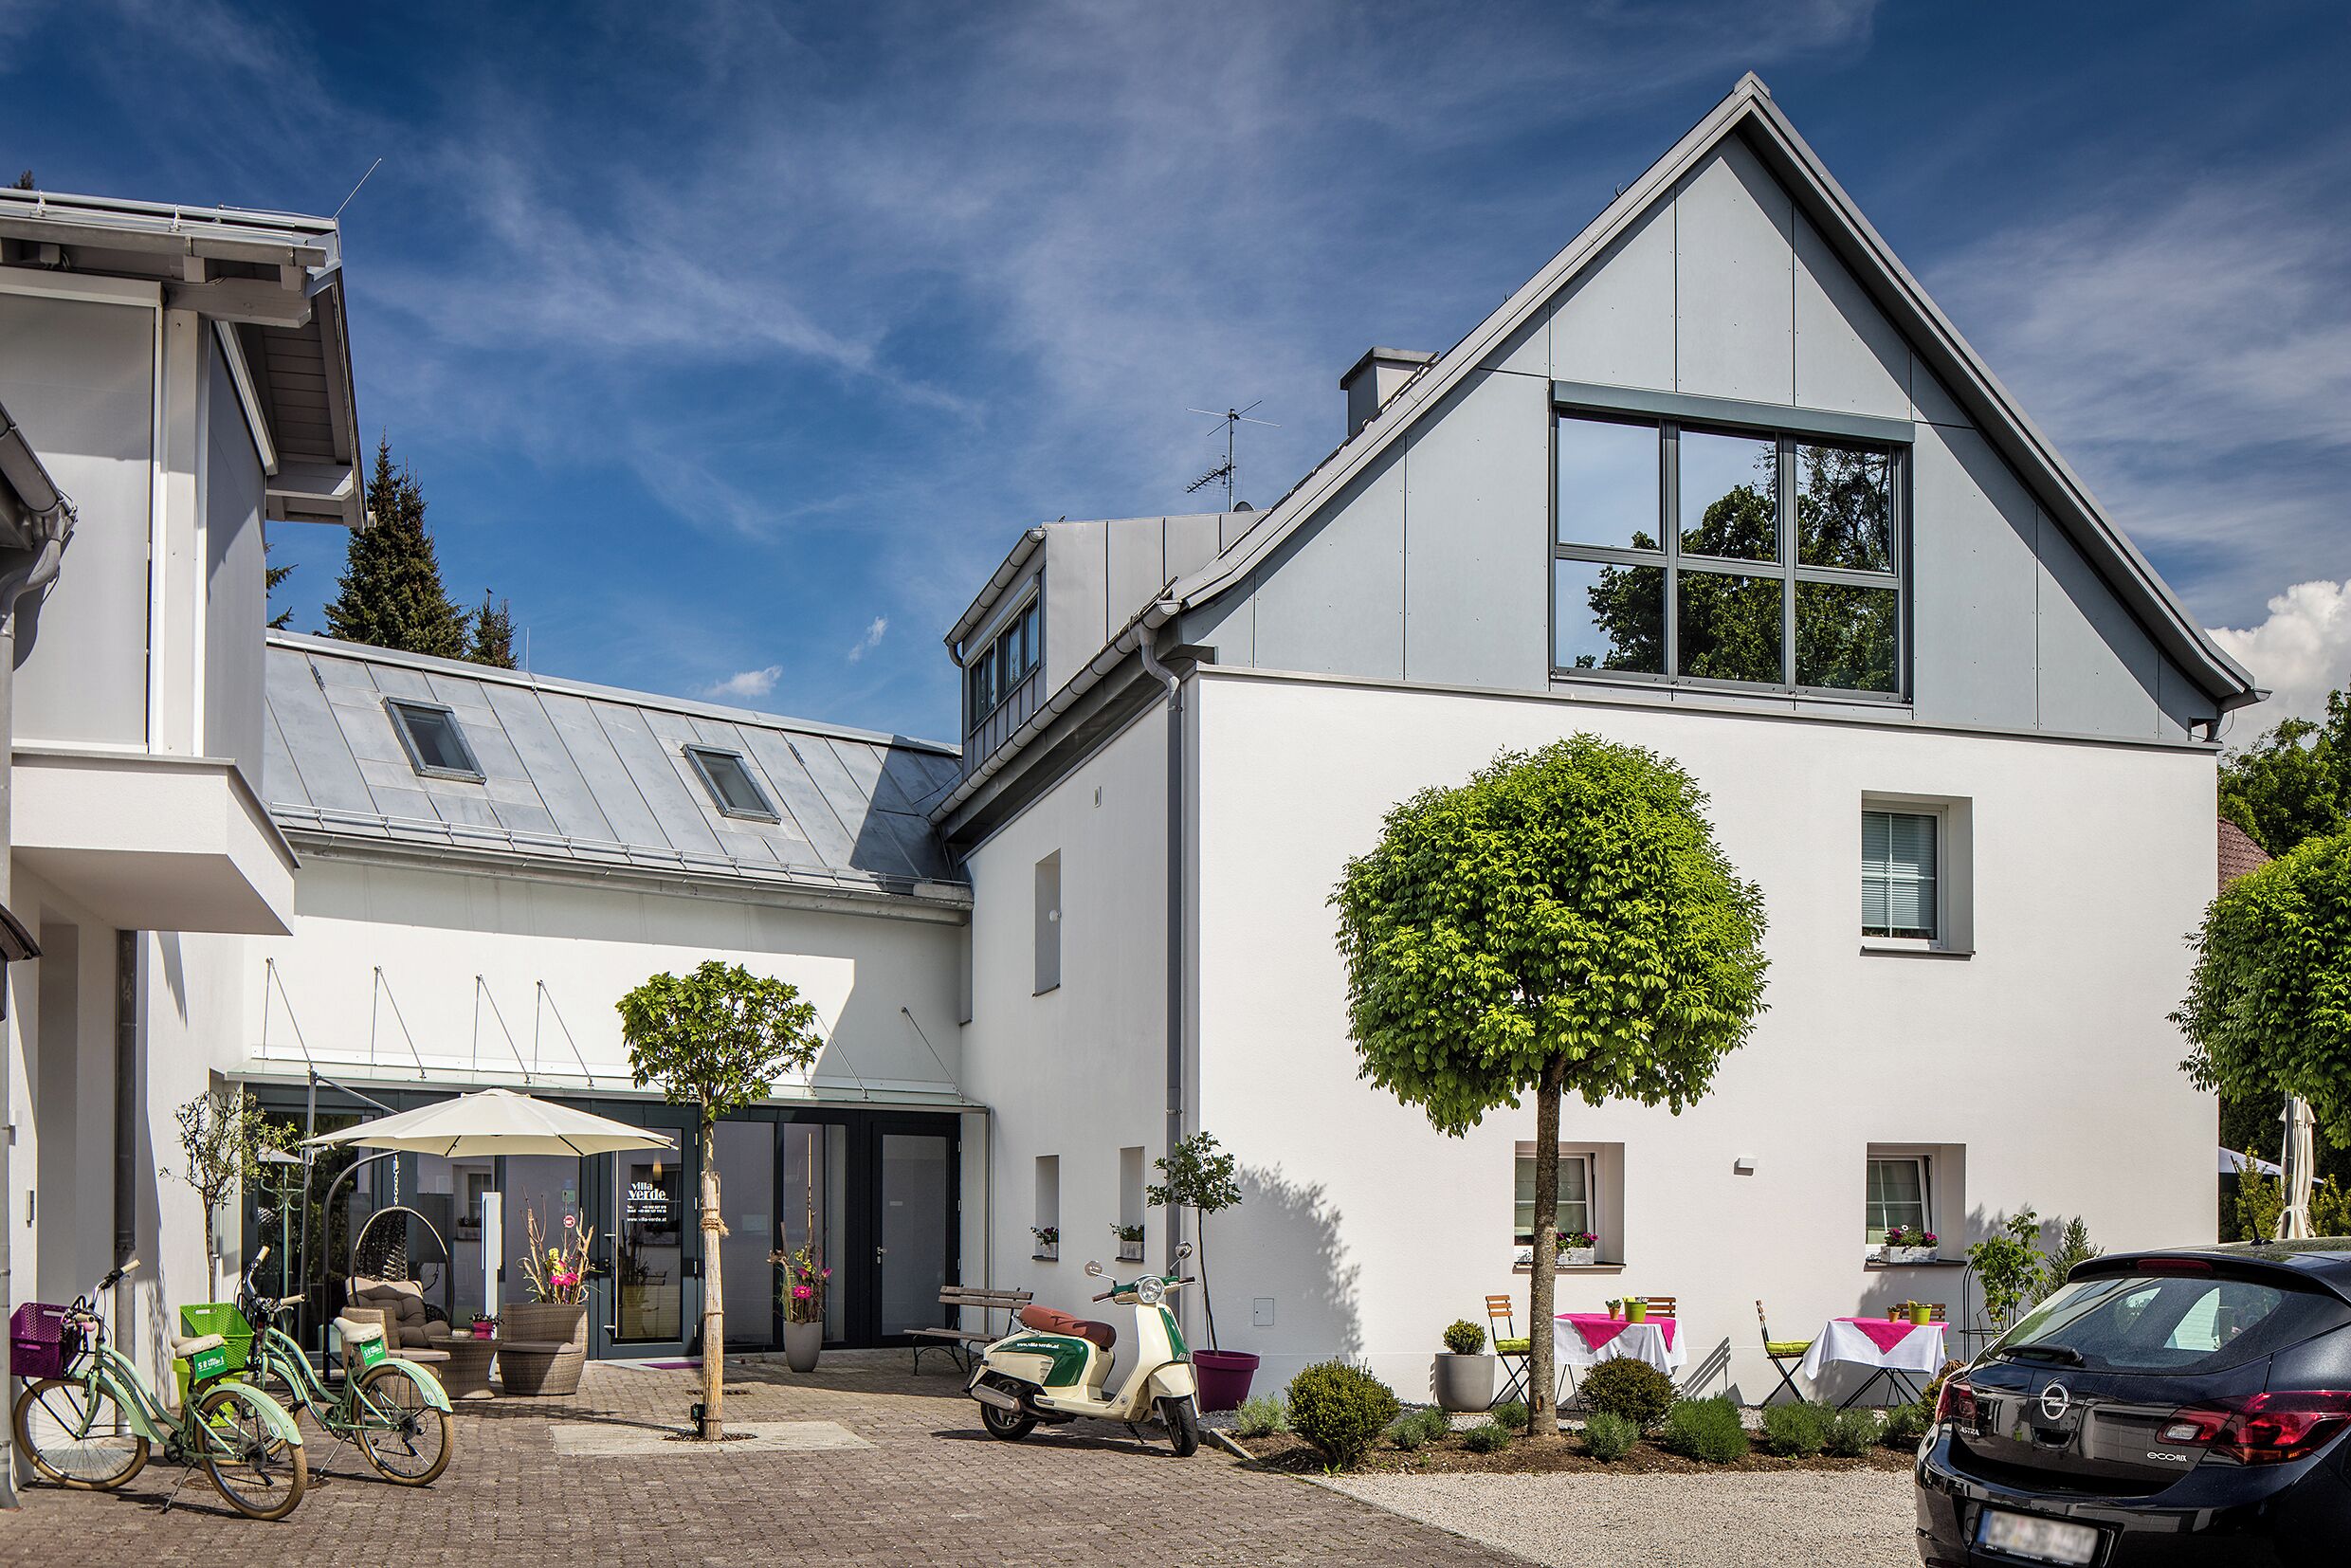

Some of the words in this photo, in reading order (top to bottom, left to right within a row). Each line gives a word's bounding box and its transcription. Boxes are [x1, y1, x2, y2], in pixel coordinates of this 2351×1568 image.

[630, 1181, 653, 1191] villa
[628, 1188, 666, 1200] verde
[1959, 1426, 1979, 1436] ASTRA
